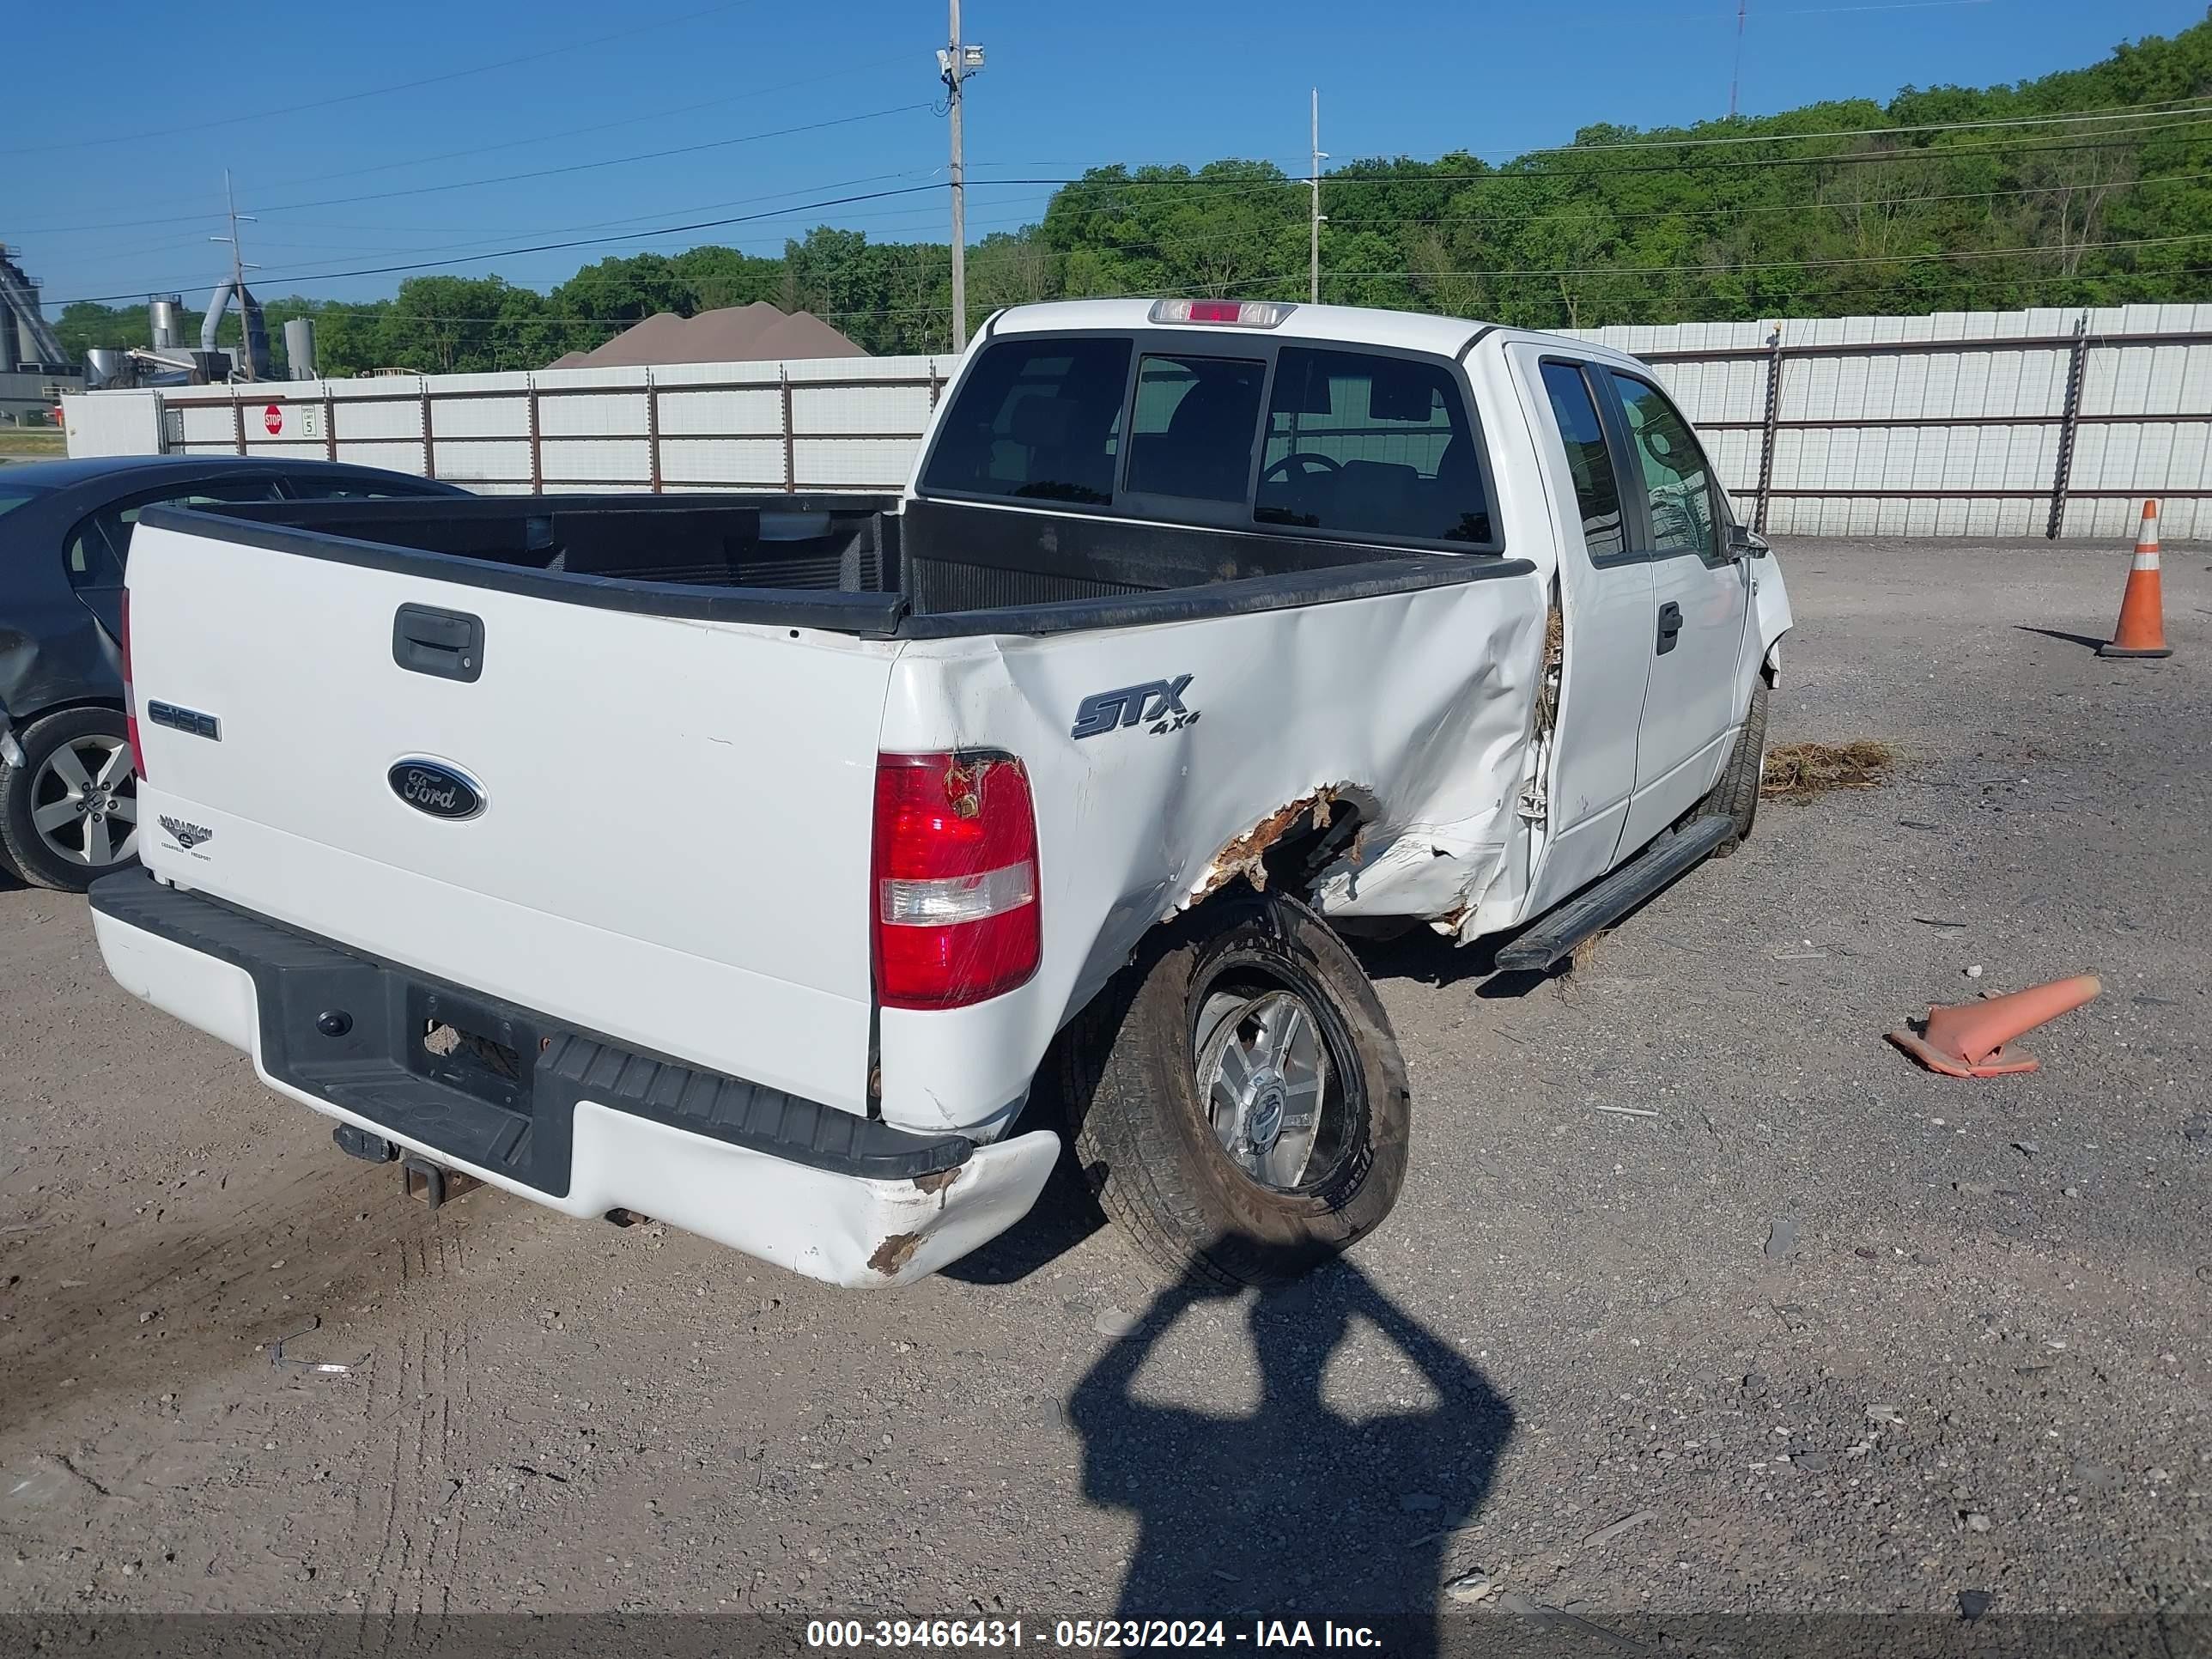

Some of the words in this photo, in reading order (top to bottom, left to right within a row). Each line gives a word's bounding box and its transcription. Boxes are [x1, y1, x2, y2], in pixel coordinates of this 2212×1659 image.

[265, 415, 282, 426] STOP
[306, 422, 313, 432] 5
[1071, 673, 1194, 740] STX
[404, 769, 456, 808] Ford
[191, 852, 212, 862] FREEPORT
